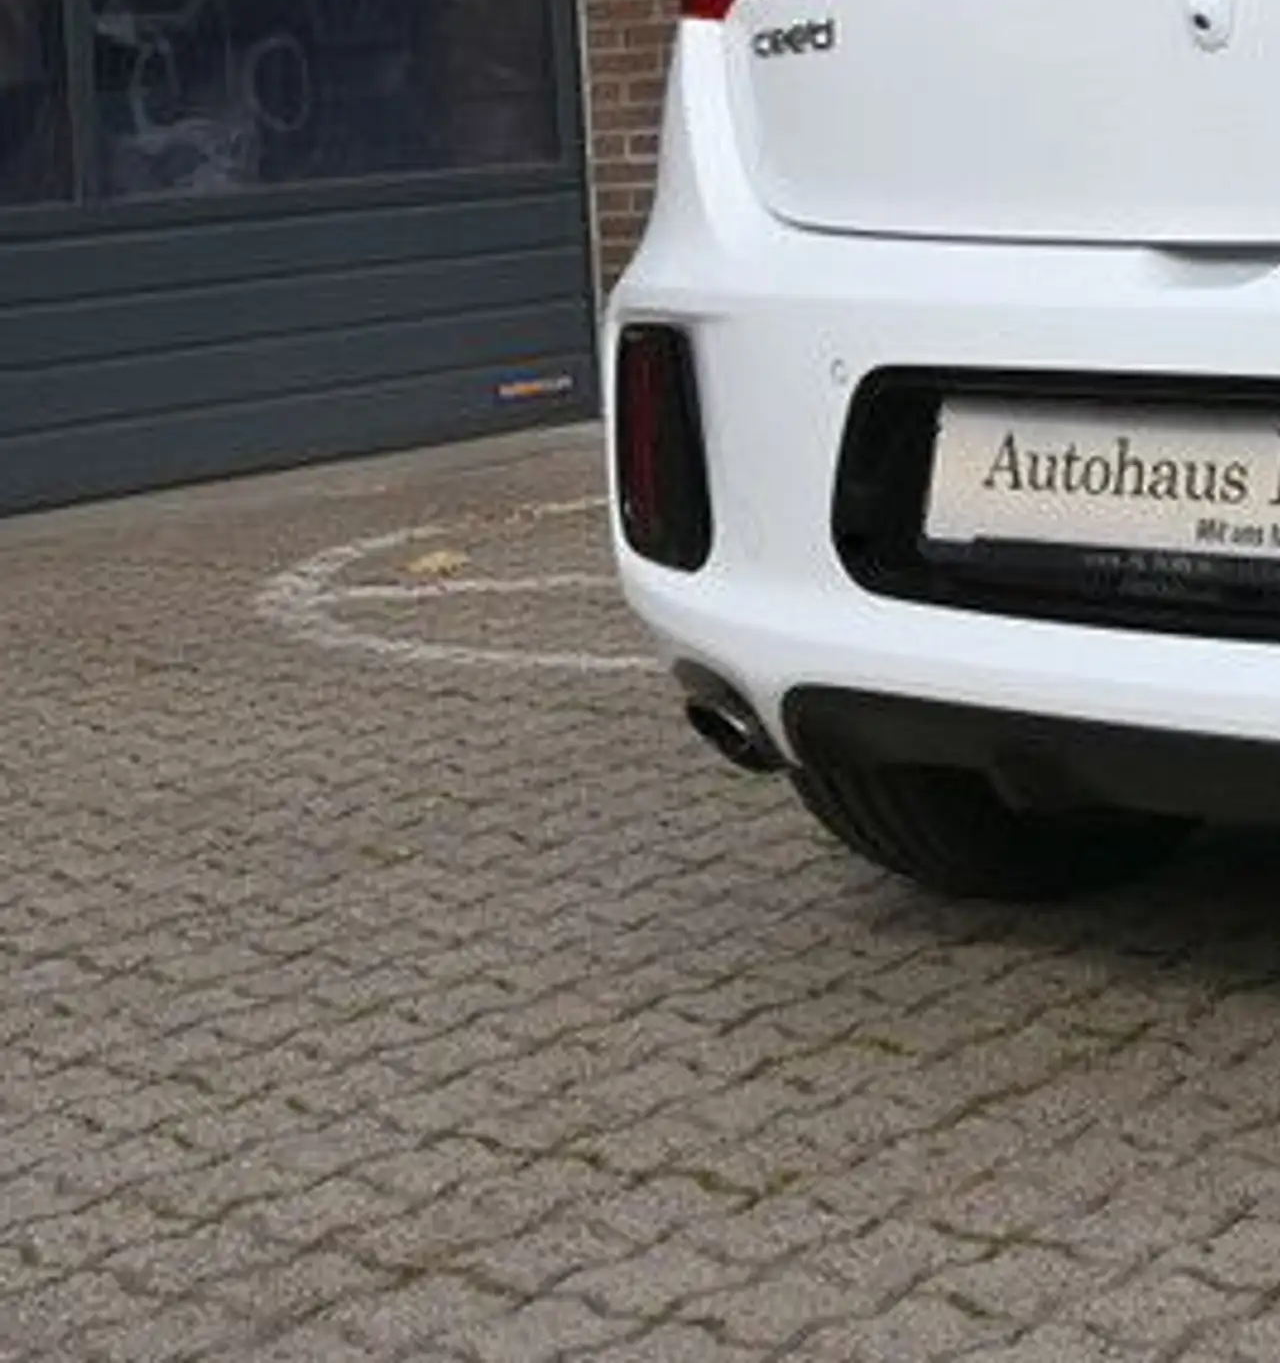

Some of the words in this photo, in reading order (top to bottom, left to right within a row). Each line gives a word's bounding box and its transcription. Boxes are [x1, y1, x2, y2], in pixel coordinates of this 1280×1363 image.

[981, 432, 1251, 504] Autohaus
[1195, 518, 1228, 543] Mit
[1231, 524, 1264, 547] uns
